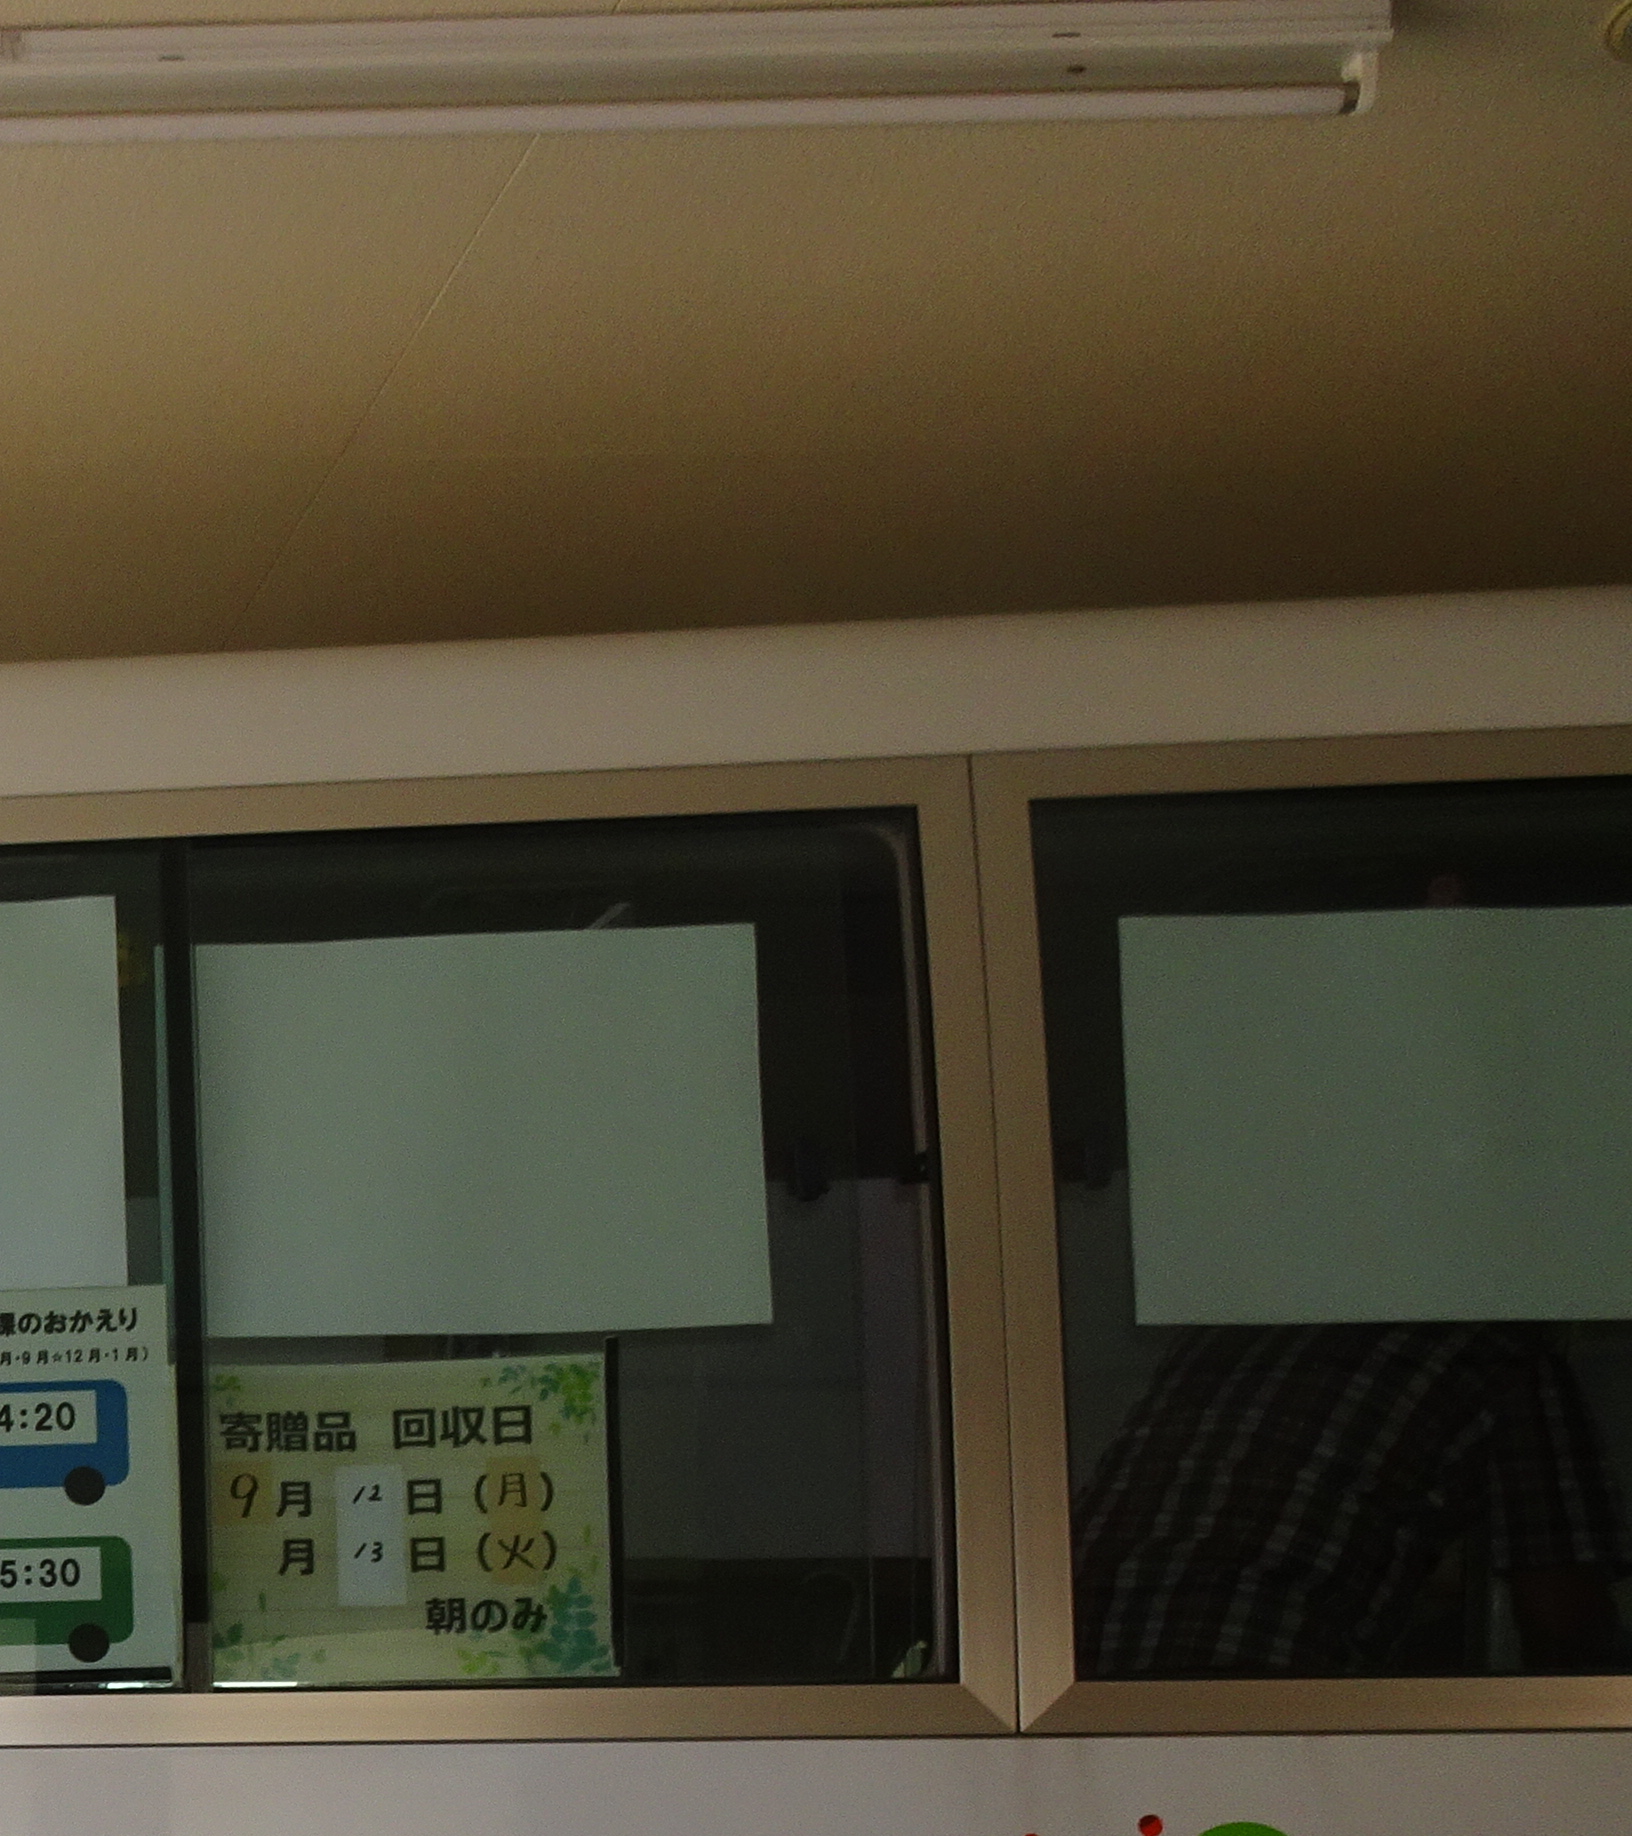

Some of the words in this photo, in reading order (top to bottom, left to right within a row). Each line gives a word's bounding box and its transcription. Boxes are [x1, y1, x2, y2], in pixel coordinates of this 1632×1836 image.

[220, 1411, 357, 1452] 寄贈品
[393, 1405, 533, 1449] 回収日
[425, 1597, 547, 1635] 朝のみ
